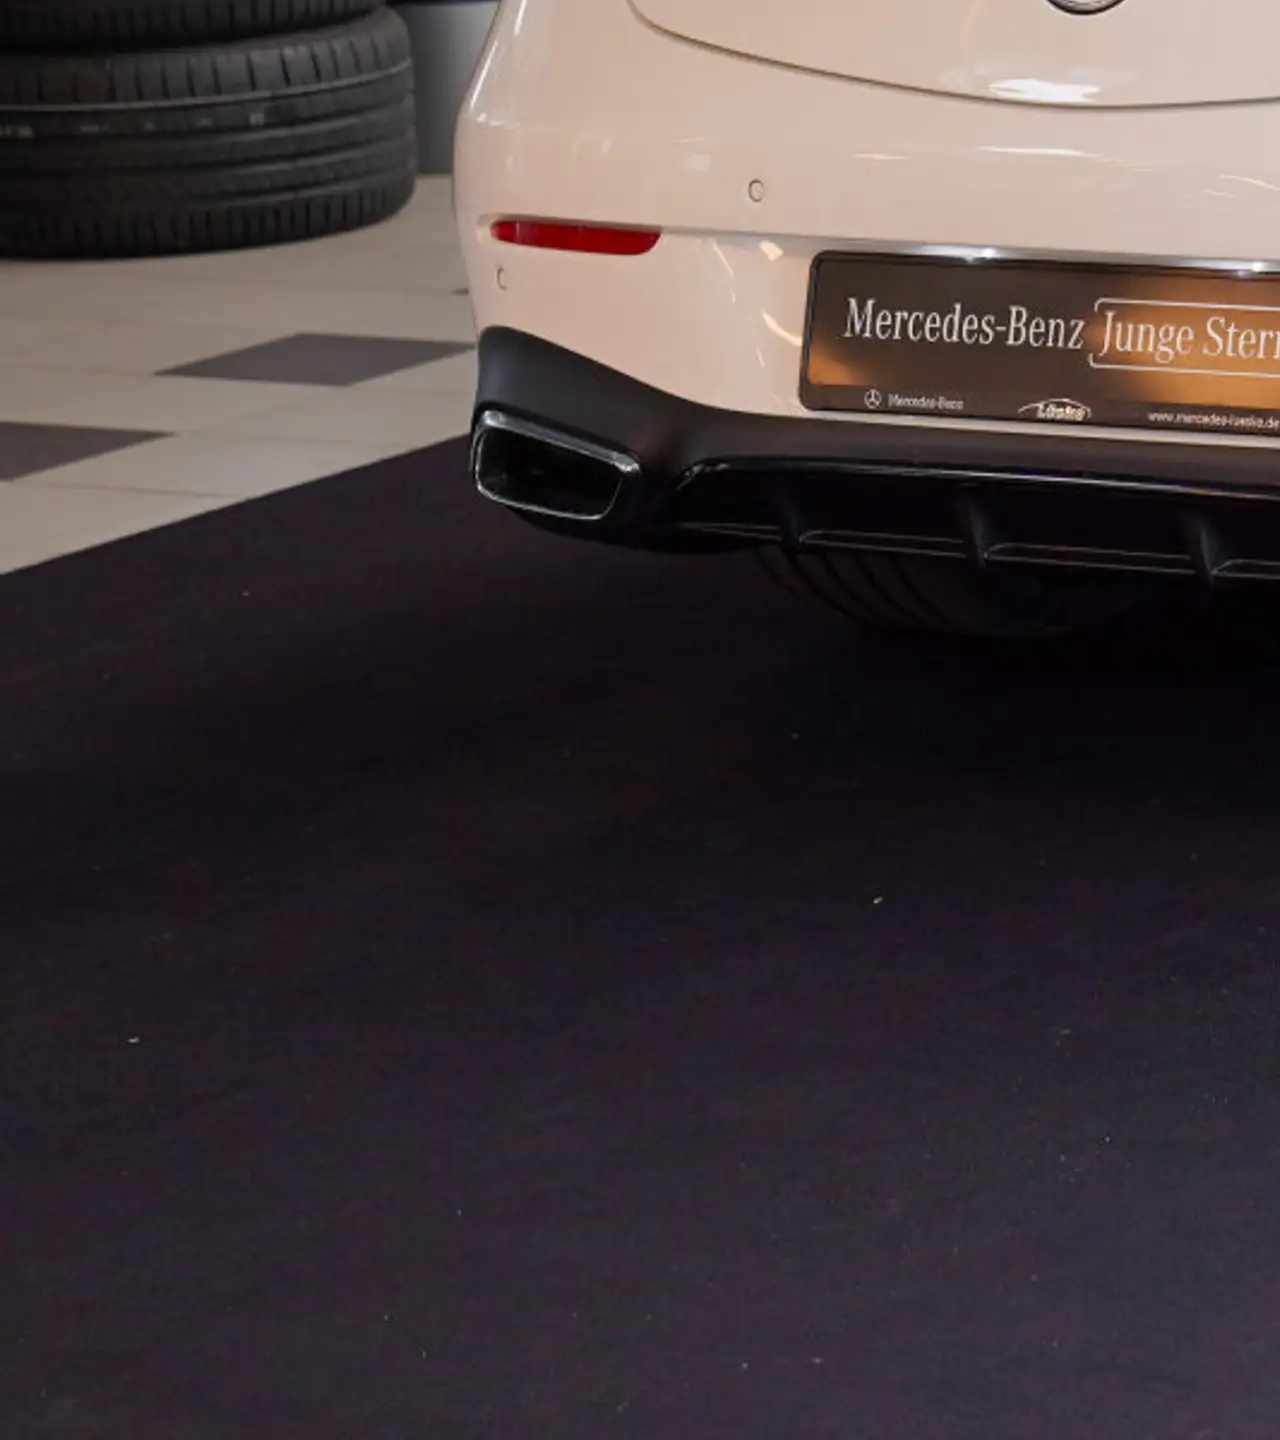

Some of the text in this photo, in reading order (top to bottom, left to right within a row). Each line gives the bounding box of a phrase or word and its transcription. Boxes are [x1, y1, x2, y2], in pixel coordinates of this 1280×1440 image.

[843, 297, 1086, 350] Mercedes-Benz
[1098, 310, 1195, 363] Junge
[888, 393, 964, 410] Mercedes-Benz
